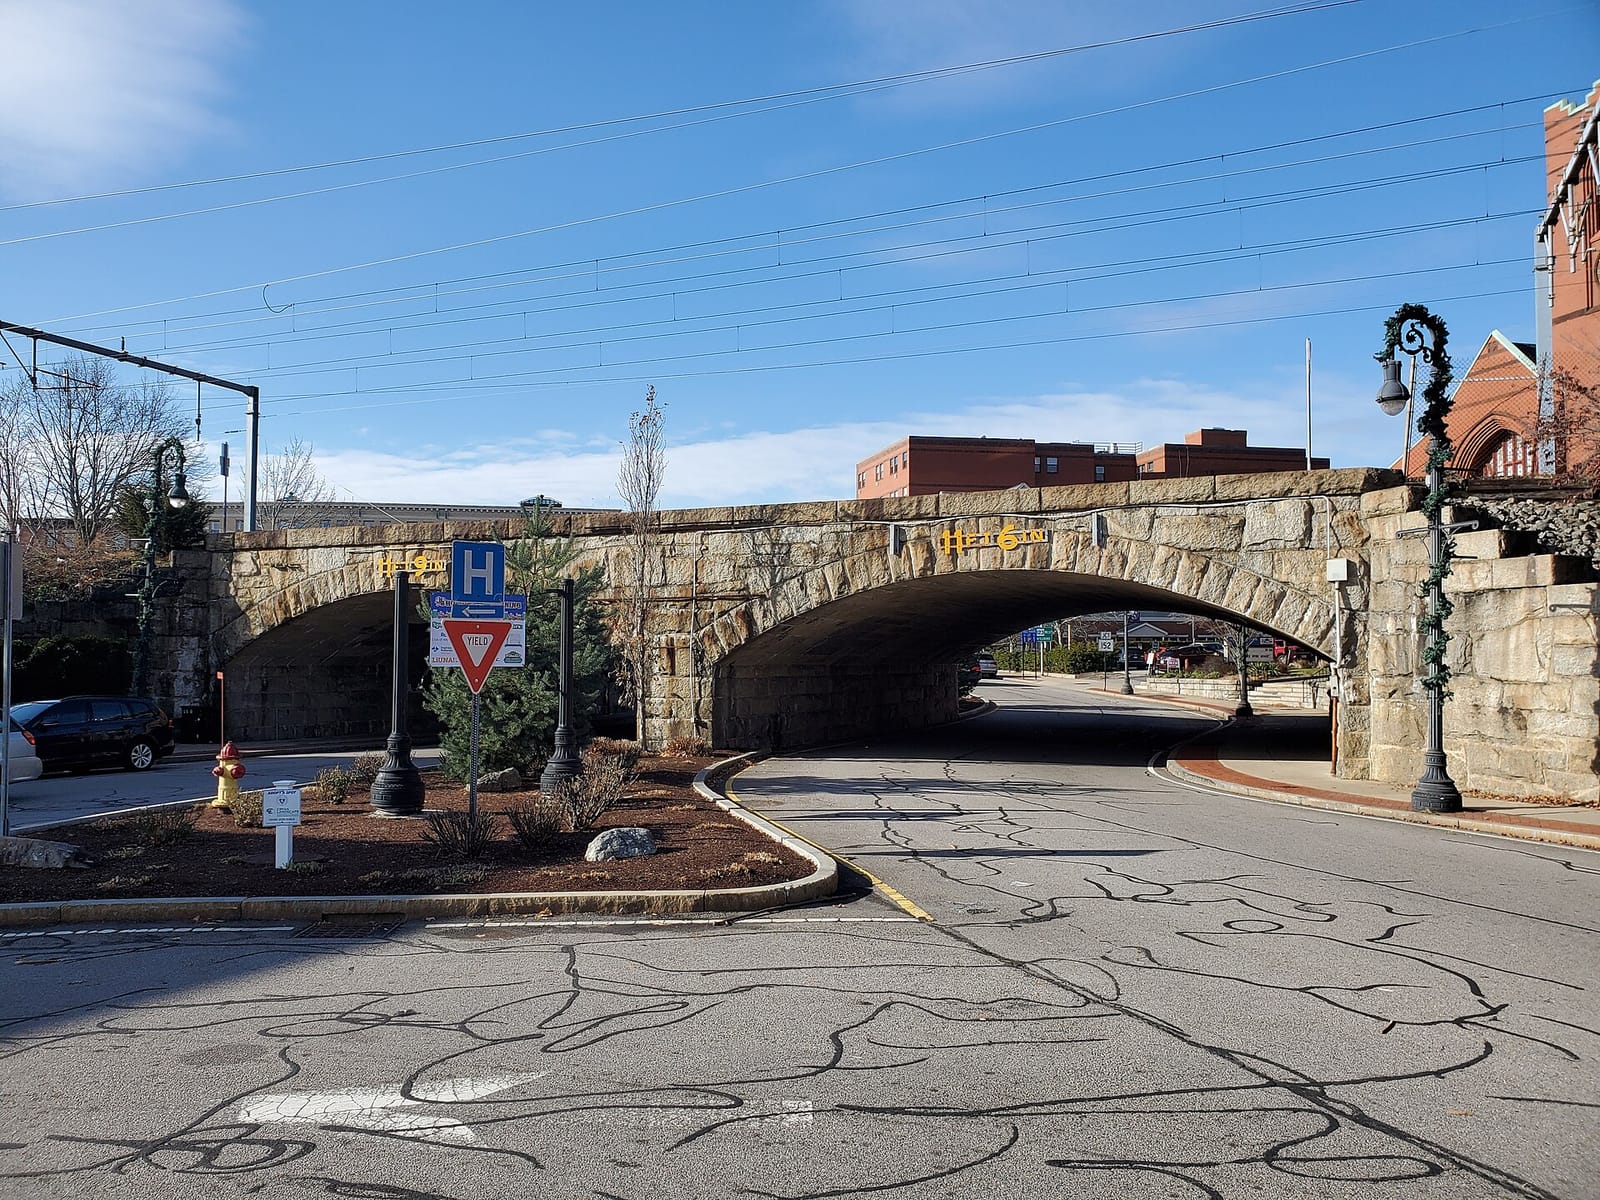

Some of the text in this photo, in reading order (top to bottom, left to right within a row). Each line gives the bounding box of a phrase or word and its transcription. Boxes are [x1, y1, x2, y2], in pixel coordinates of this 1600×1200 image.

[965, 532, 990, 546] FT
[997, 524, 1019, 551] 6
[1022, 528, 1044, 543] IN
[414, 555, 428, 577] 9
[429, 560, 445, 572] IN
[464, 549, 494, 596] H
[467, 636, 489, 646] YIELD
